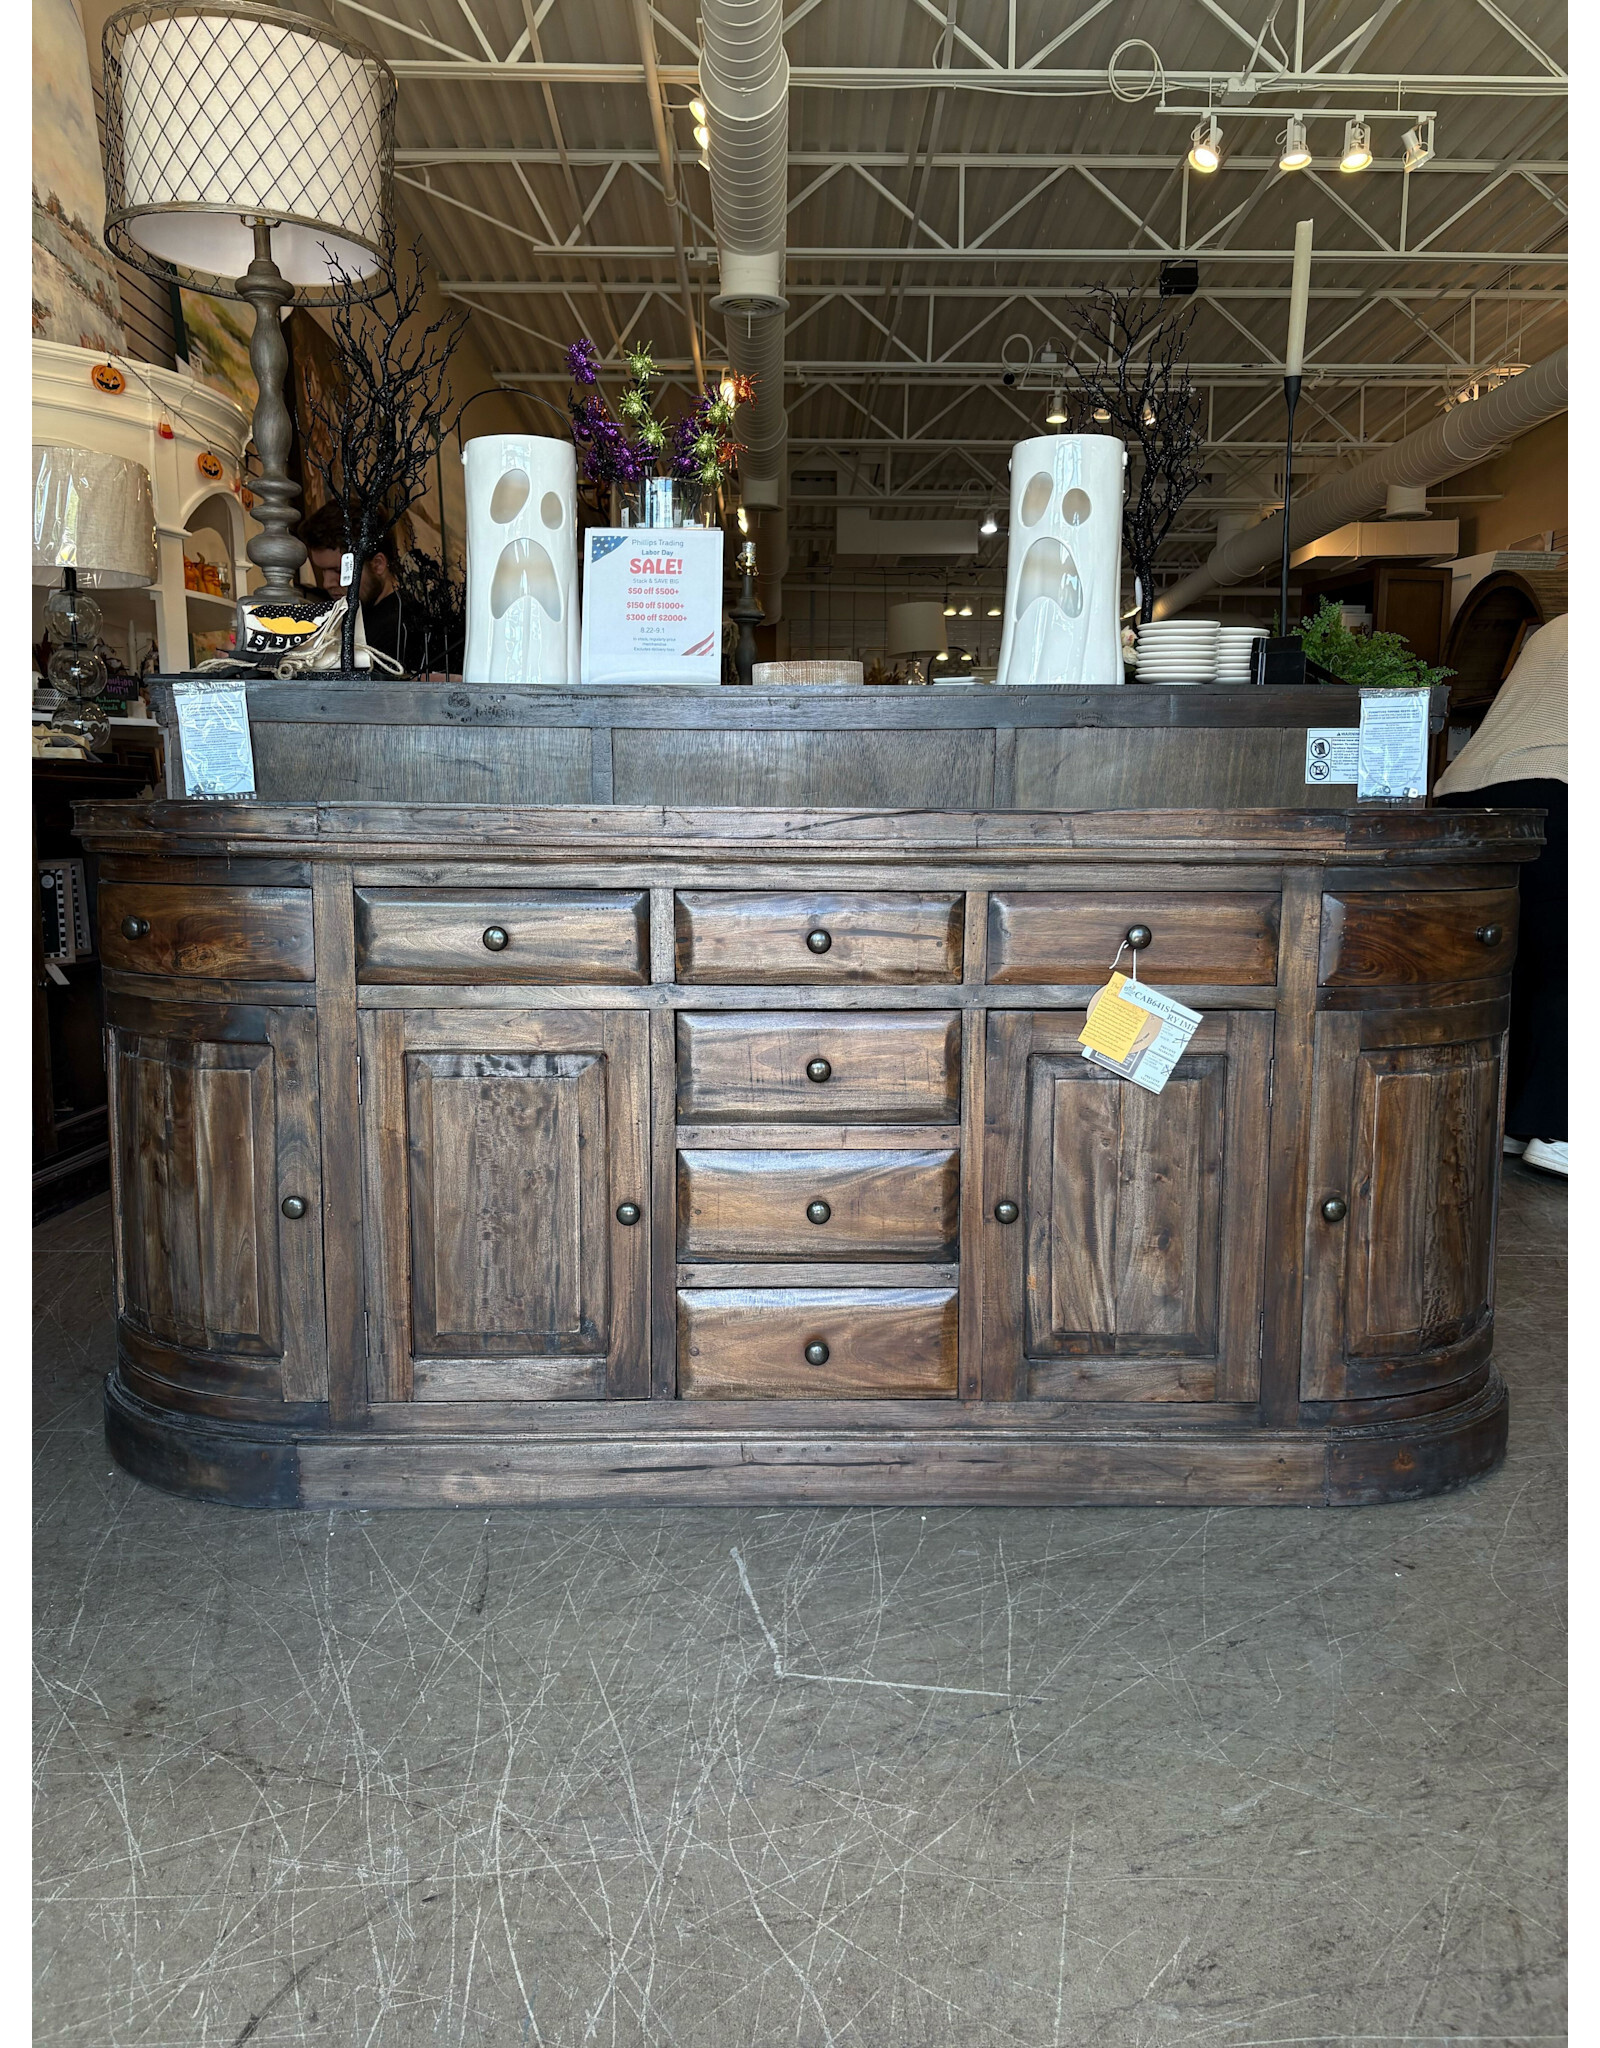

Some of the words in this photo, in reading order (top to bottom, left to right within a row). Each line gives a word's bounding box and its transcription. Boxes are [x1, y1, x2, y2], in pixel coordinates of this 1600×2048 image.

[631, 539, 657, 547] Phillips
[658, 539, 684, 548] Trading
[661, 549, 674, 557] Day
[630, 558, 683, 574] SALE!
[628, 587, 643, 595] $50
[655, 587, 679, 595] $500+
[626, 601, 644, 609] $150
[645, 601, 656, 609] off
[625, 613, 645, 621] $300
[646, 613, 657, 621] off
[658, 614, 687, 622] $2000+
[640, 626, 665, 634] 8.22-9.1
